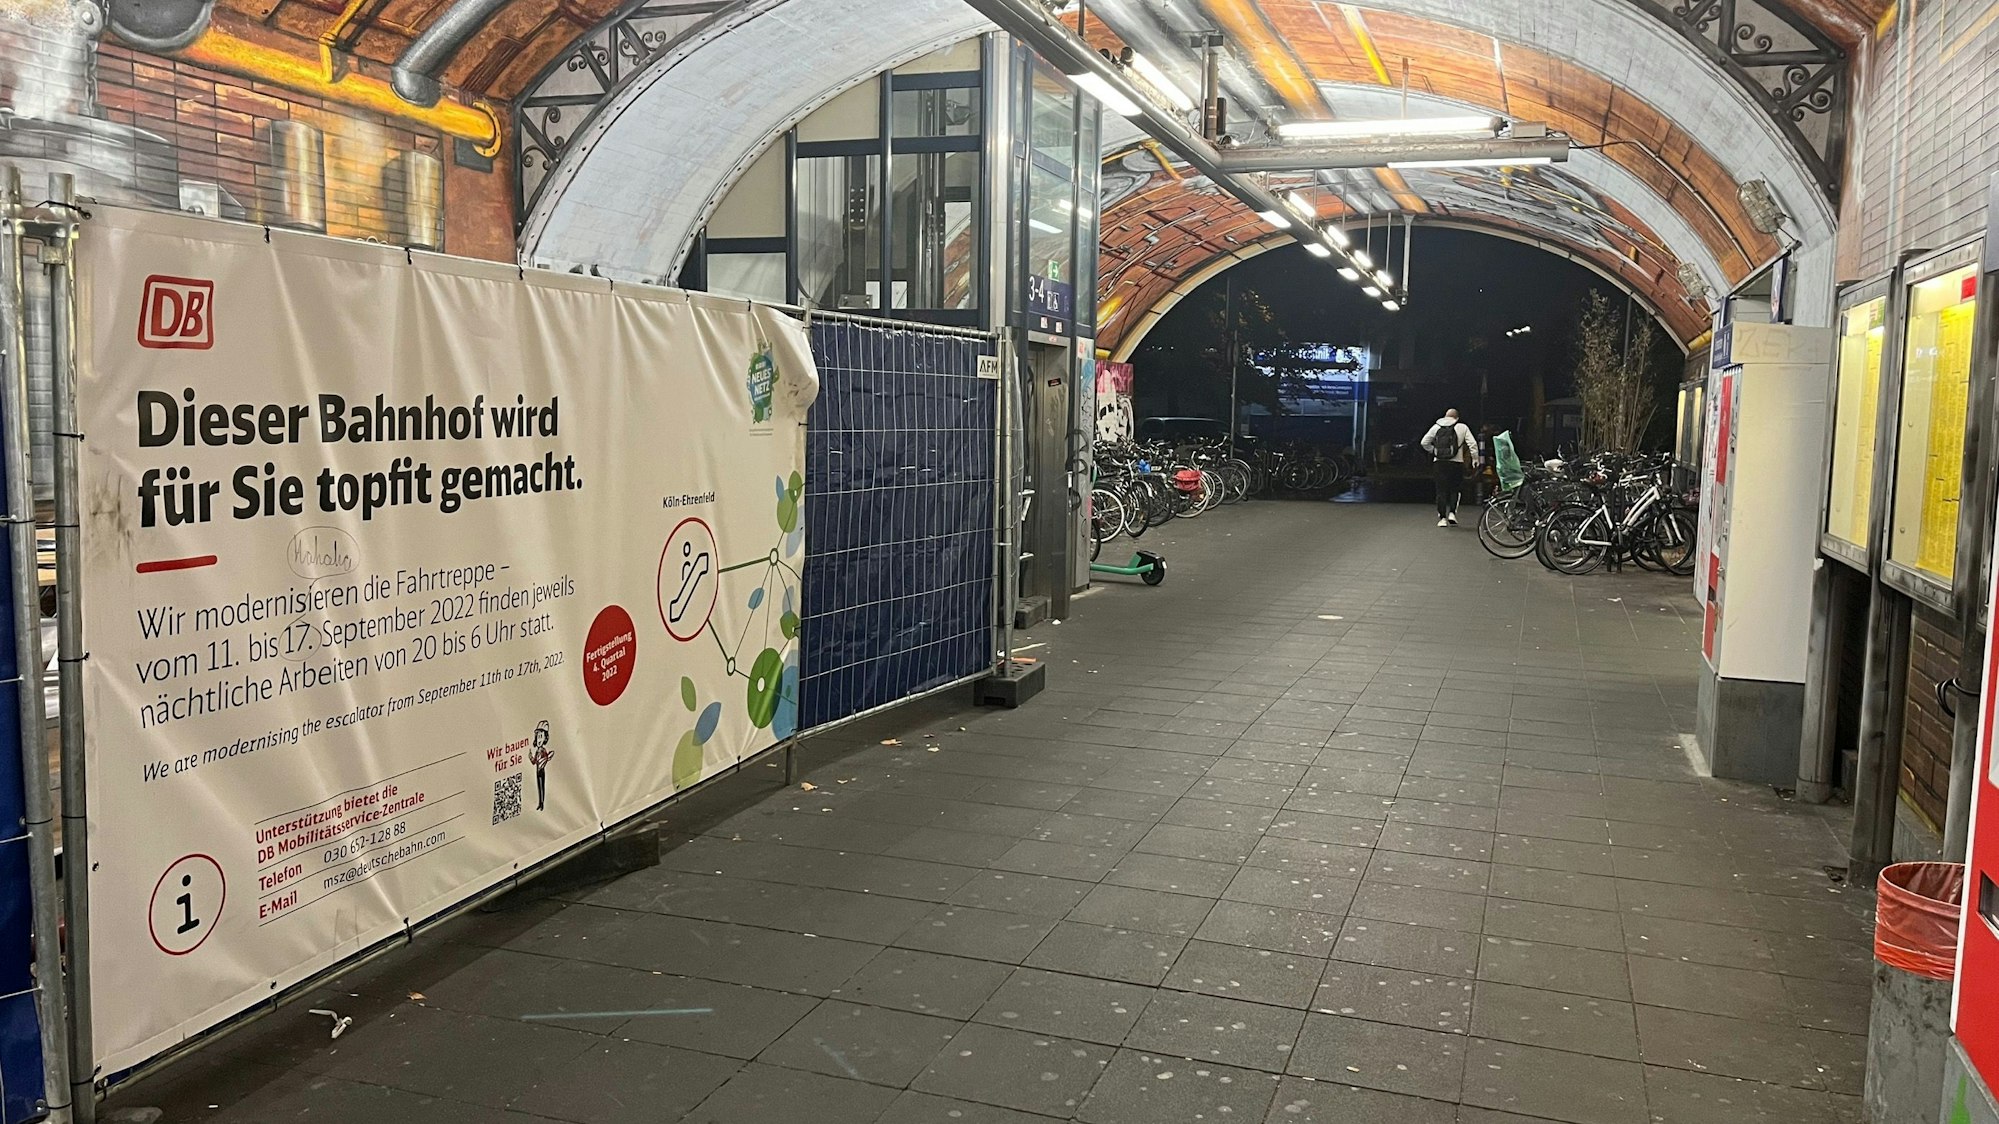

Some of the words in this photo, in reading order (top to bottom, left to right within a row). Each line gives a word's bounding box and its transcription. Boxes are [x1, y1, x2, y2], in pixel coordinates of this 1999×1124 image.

[151, 288, 205, 337] DB
[751, 368, 772, 385] NEUES
[754, 381, 770, 396] NETZ
[979, 359, 998, 374] AFM
[137, 387, 309, 447] Dieser
[318, 393, 484, 444] Bahnhof
[491, 394, 558, 439] wird
[137, 466, 220, 528] für
[232, 462, 304, 520] Sie
[316, 456, 432, 521] topfit
[440, 451, 583, 514] gemacht.
[662, 491, 715, 508] Köln-Ehrenfeld
[137, 606, 186, 640] Wir
[196, 585, 358, 632] modernisieren
[363, 574, 391, 602] die
[396, 562, 495, 597] Fahrtreppe
[136, 652, 198, 684] vom
[207, 638, 240, 672] 11.
[249, 632, 279, 662] bis
[284, 623, 314, 655] 17.
[322, 606, 425, 648] September
[430, 593, 475, 626] 2022
[478, 586, 529, 615] finden
[532, 574, 575, 609] jeweils
[586, 631, 632, 663] Fertigstellung
[140, 675, 273, 729] nächtliche
[279, 657, 368, 696] Arbeiten
[374, 647, 407, 673] von
[412, 635, 437, 664] 20
[443, 630, 466, 656] bis
[470, 624, 481, 649] 6
[486, 619, 516, 646] Uhr
[520, 612, 554, 639] statt.
[593, 663, 600, 673] 4.
[600, 646, 626, 670] Quartal
[602, 665, 618, 682] 2022
[143, 759, 169, 783] We
[174, 753, 198, 774] are
[202, 726, 299, 765] modernising
[302, 718, 321, 737] the
[326, 703, 385, 729] escalator
[387, 694, 414, 717] from
[418, 678, 477, 706] September
[480, 670, 502, 688] 11th
[504, 666, 514, 681] to
[516, 659, 541, 677] 17th,
[544, 651, 565, 671] 2022.
[486, 746, 502, 761] Wir
[505, 737, 529, 754] bauen
[495, 759, 507, 773] für
[510, 753, 523, 767] Sie
[255, 804, 342, 845] Unterstützung
[343, 792, 380, 812] bietet
[382, 784, 398, 800] die
[258, 846, 275, 864] DB
[278, 791, 425, 856] Mobilitätsservice-Zentrale
[258, 890, 298, 920] E-Mail
[323, 830, 446, 890] msz@deutschebahn.com
[259, 863, 303, 892] Telefon
[323, 845, 347, 864] 030
[350, 827, 391, 854] 652-128
[393, 821, 407, 836] 88
